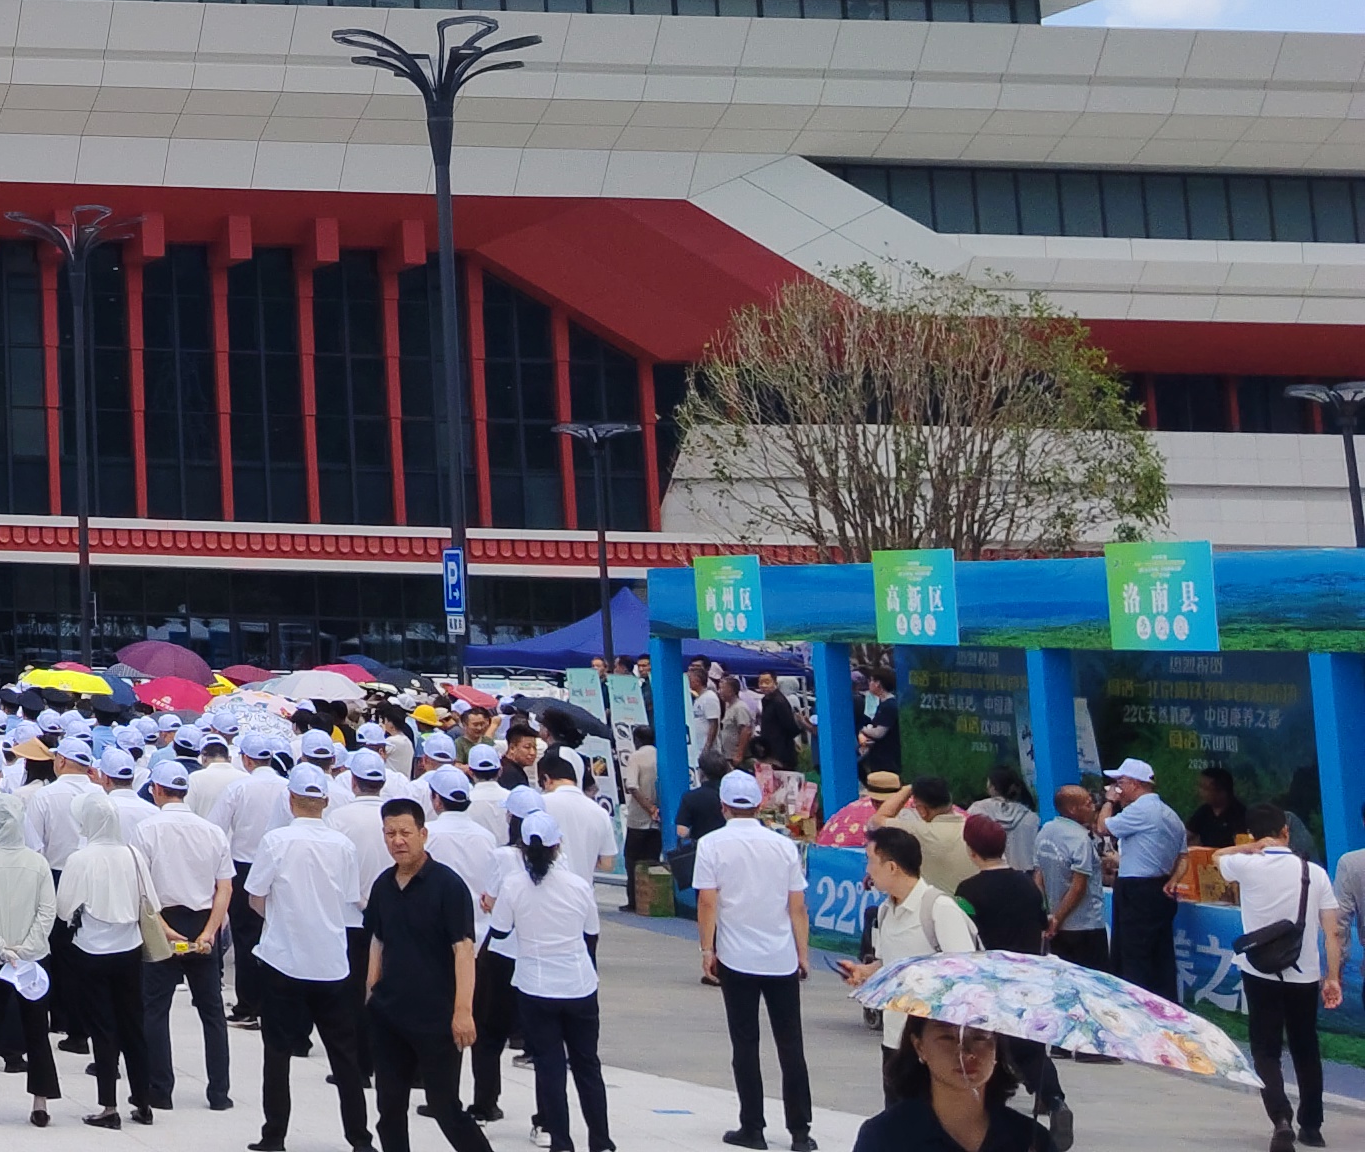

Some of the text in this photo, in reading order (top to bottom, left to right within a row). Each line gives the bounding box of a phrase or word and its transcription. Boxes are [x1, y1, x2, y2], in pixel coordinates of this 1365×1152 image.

[447, 561, 458, 600] P
[1123, 581, 1199, 614] 洛南县
